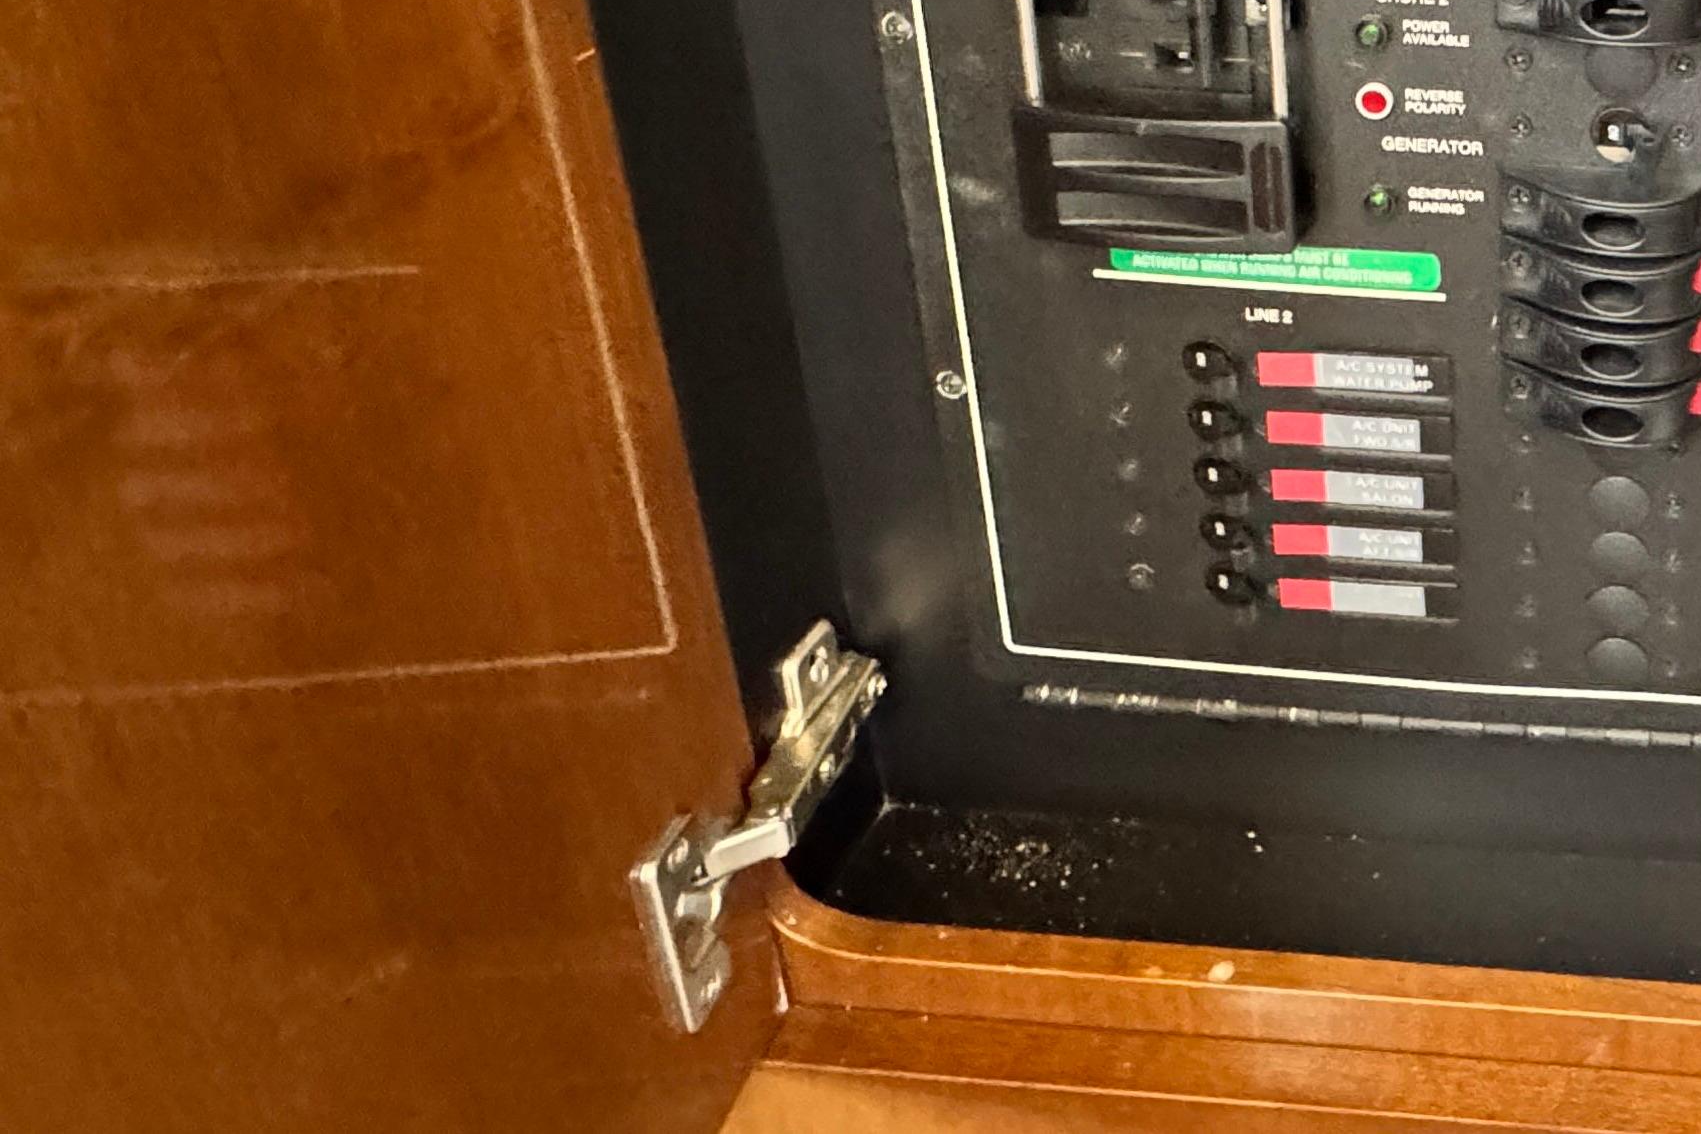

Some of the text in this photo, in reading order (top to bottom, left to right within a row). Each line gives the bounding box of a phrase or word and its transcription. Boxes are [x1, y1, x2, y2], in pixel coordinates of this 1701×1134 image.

[1402, 19, 1450, 33] POWER
[1402, 33, 1470, 48] AVAILABLE
[1404, 88, 1464, 103] REVERSE
[1405, 102, 1467, 116] POLARITY
[1381, 136, 1484, 156] GENERATOR
[1408, 186, 1485, 202] GENERATOR
[1408, 201, 1466, 216] RUNNING
[1245, 307, 1293, 324] LINE 2
